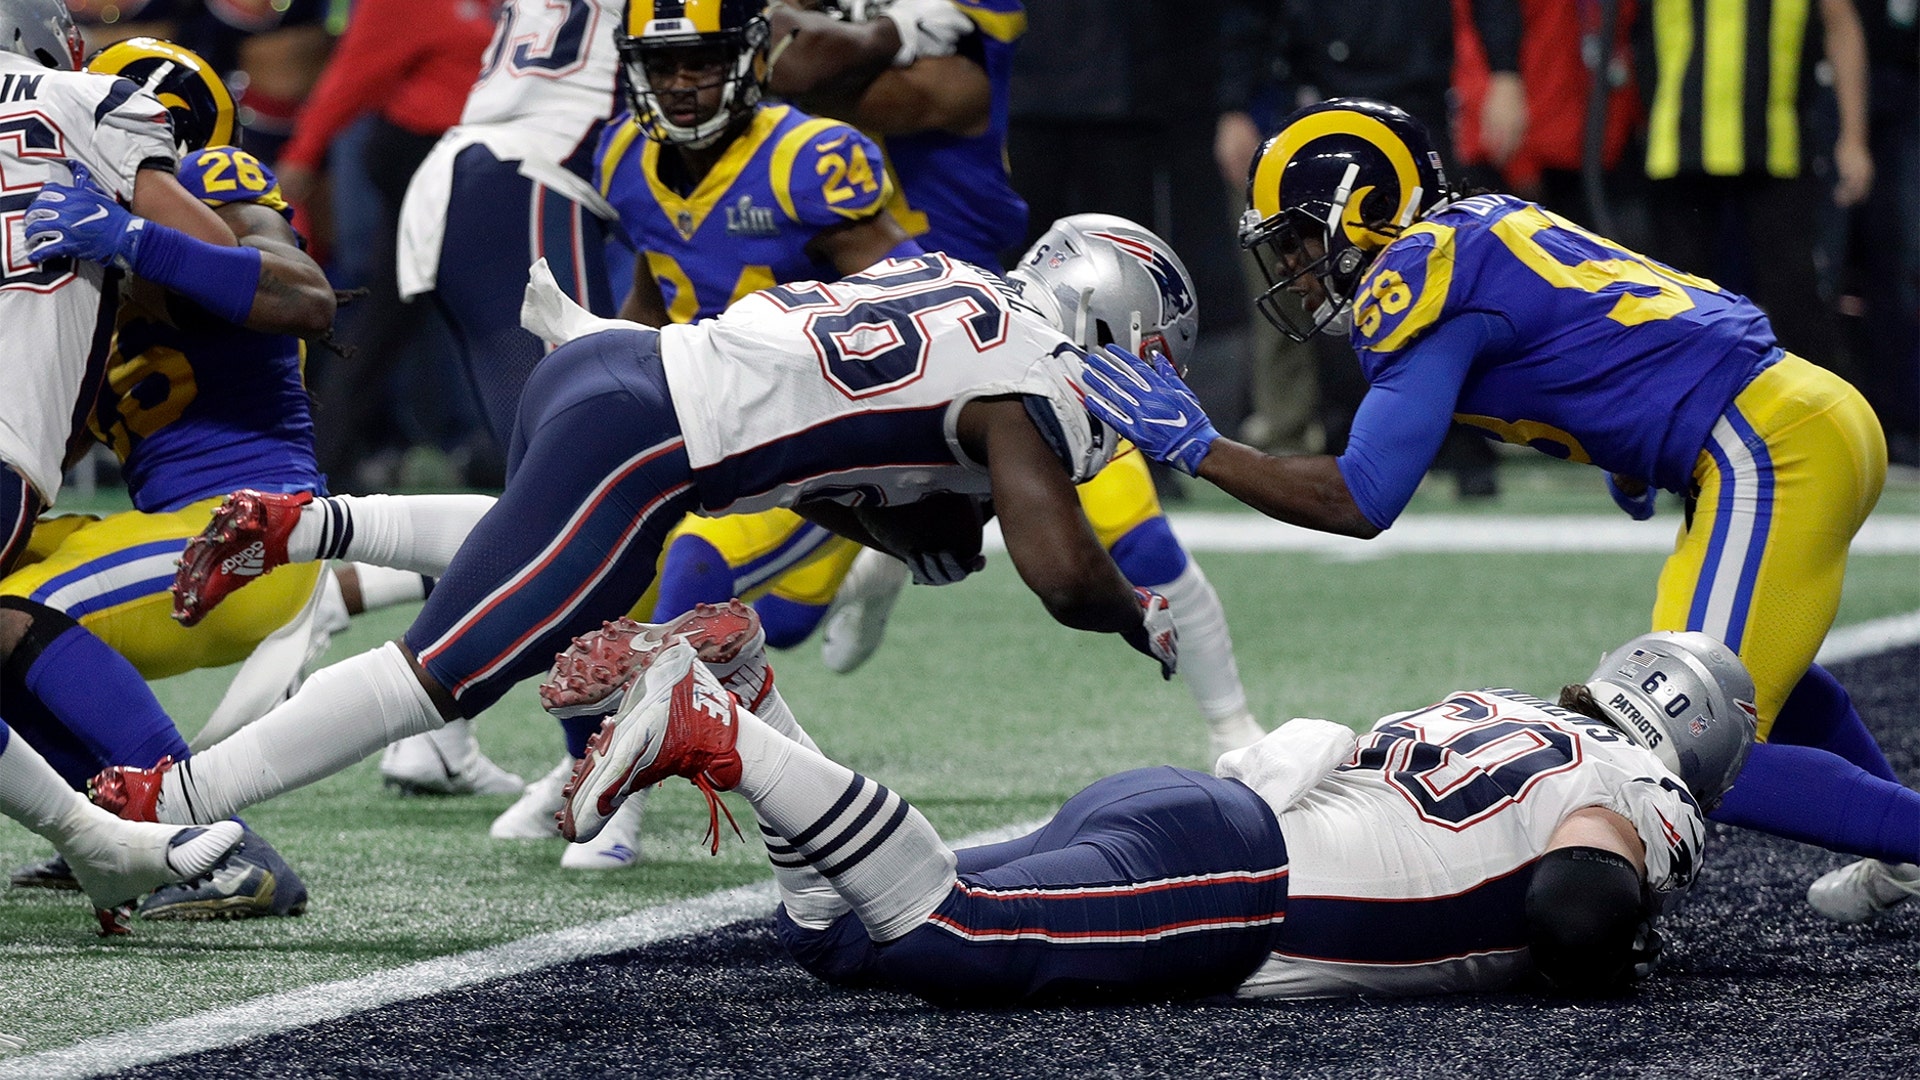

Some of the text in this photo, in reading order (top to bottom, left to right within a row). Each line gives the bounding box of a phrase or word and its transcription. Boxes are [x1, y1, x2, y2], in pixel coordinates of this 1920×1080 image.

[197, 151, 268, 194] 26
[815, 143, 879, 205] 24
[1352, 269, 1413, 338] 58
[220, 541, 264, 575] adidas
[1608, 692, 1663, 750] PATRIOTS
[1641, 670, 1692, 719] 60
[1335, 692, 1583, 833] 60
